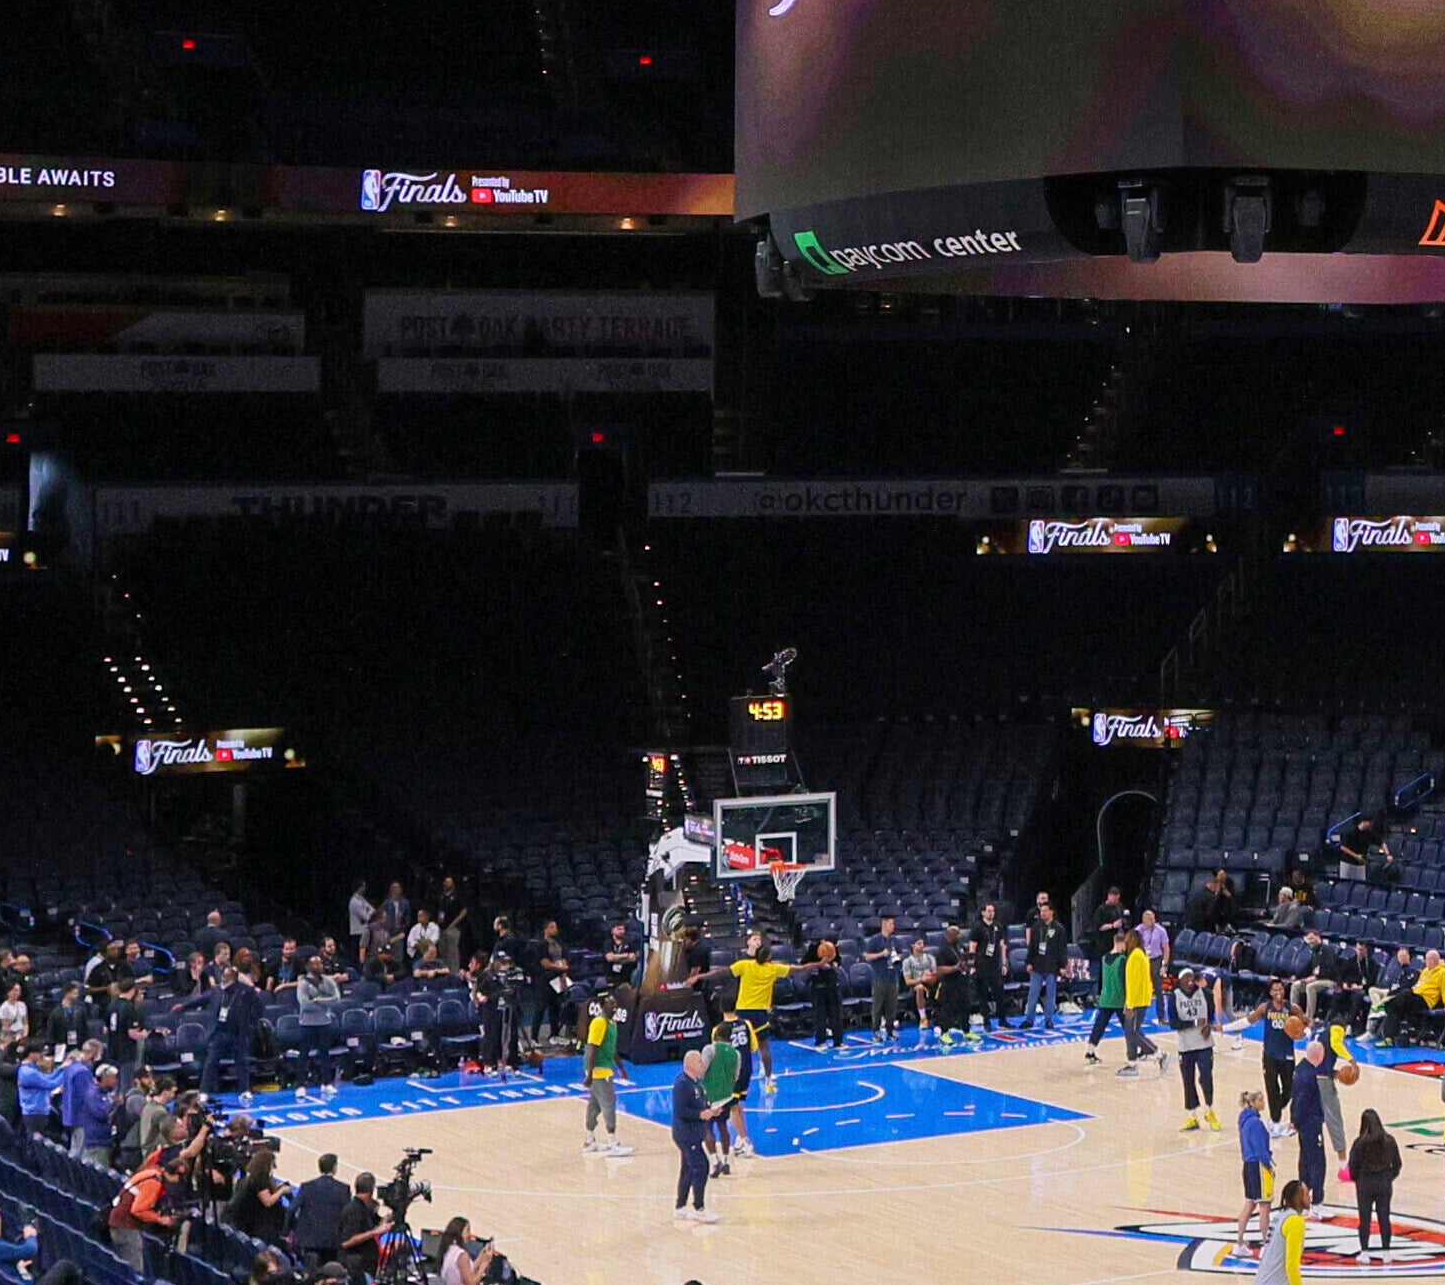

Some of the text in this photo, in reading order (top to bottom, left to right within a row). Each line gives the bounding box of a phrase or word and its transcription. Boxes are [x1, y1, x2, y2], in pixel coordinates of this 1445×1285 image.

[37, 168, 116, 188] AWAITS
[375, 172, 467, 213] Finals
[833, 226, 1022, 276] paycom center
[399, 314, 447, 336] POST
[479, 315, 516, 337] OAK
[231, 495, 446, 525] THUNDER
[1041, 520, 1111, 554] Finals
[1346, 517, 1413, 553] Finals
[1099, 714, 1162, 746] Finals
[142, 738, 215, 775] Finals
[752, 753, 787, 765] TISSOT
[653, 1009, 705, 1041] Finals
[730, 1031, 747, 1046] 26
